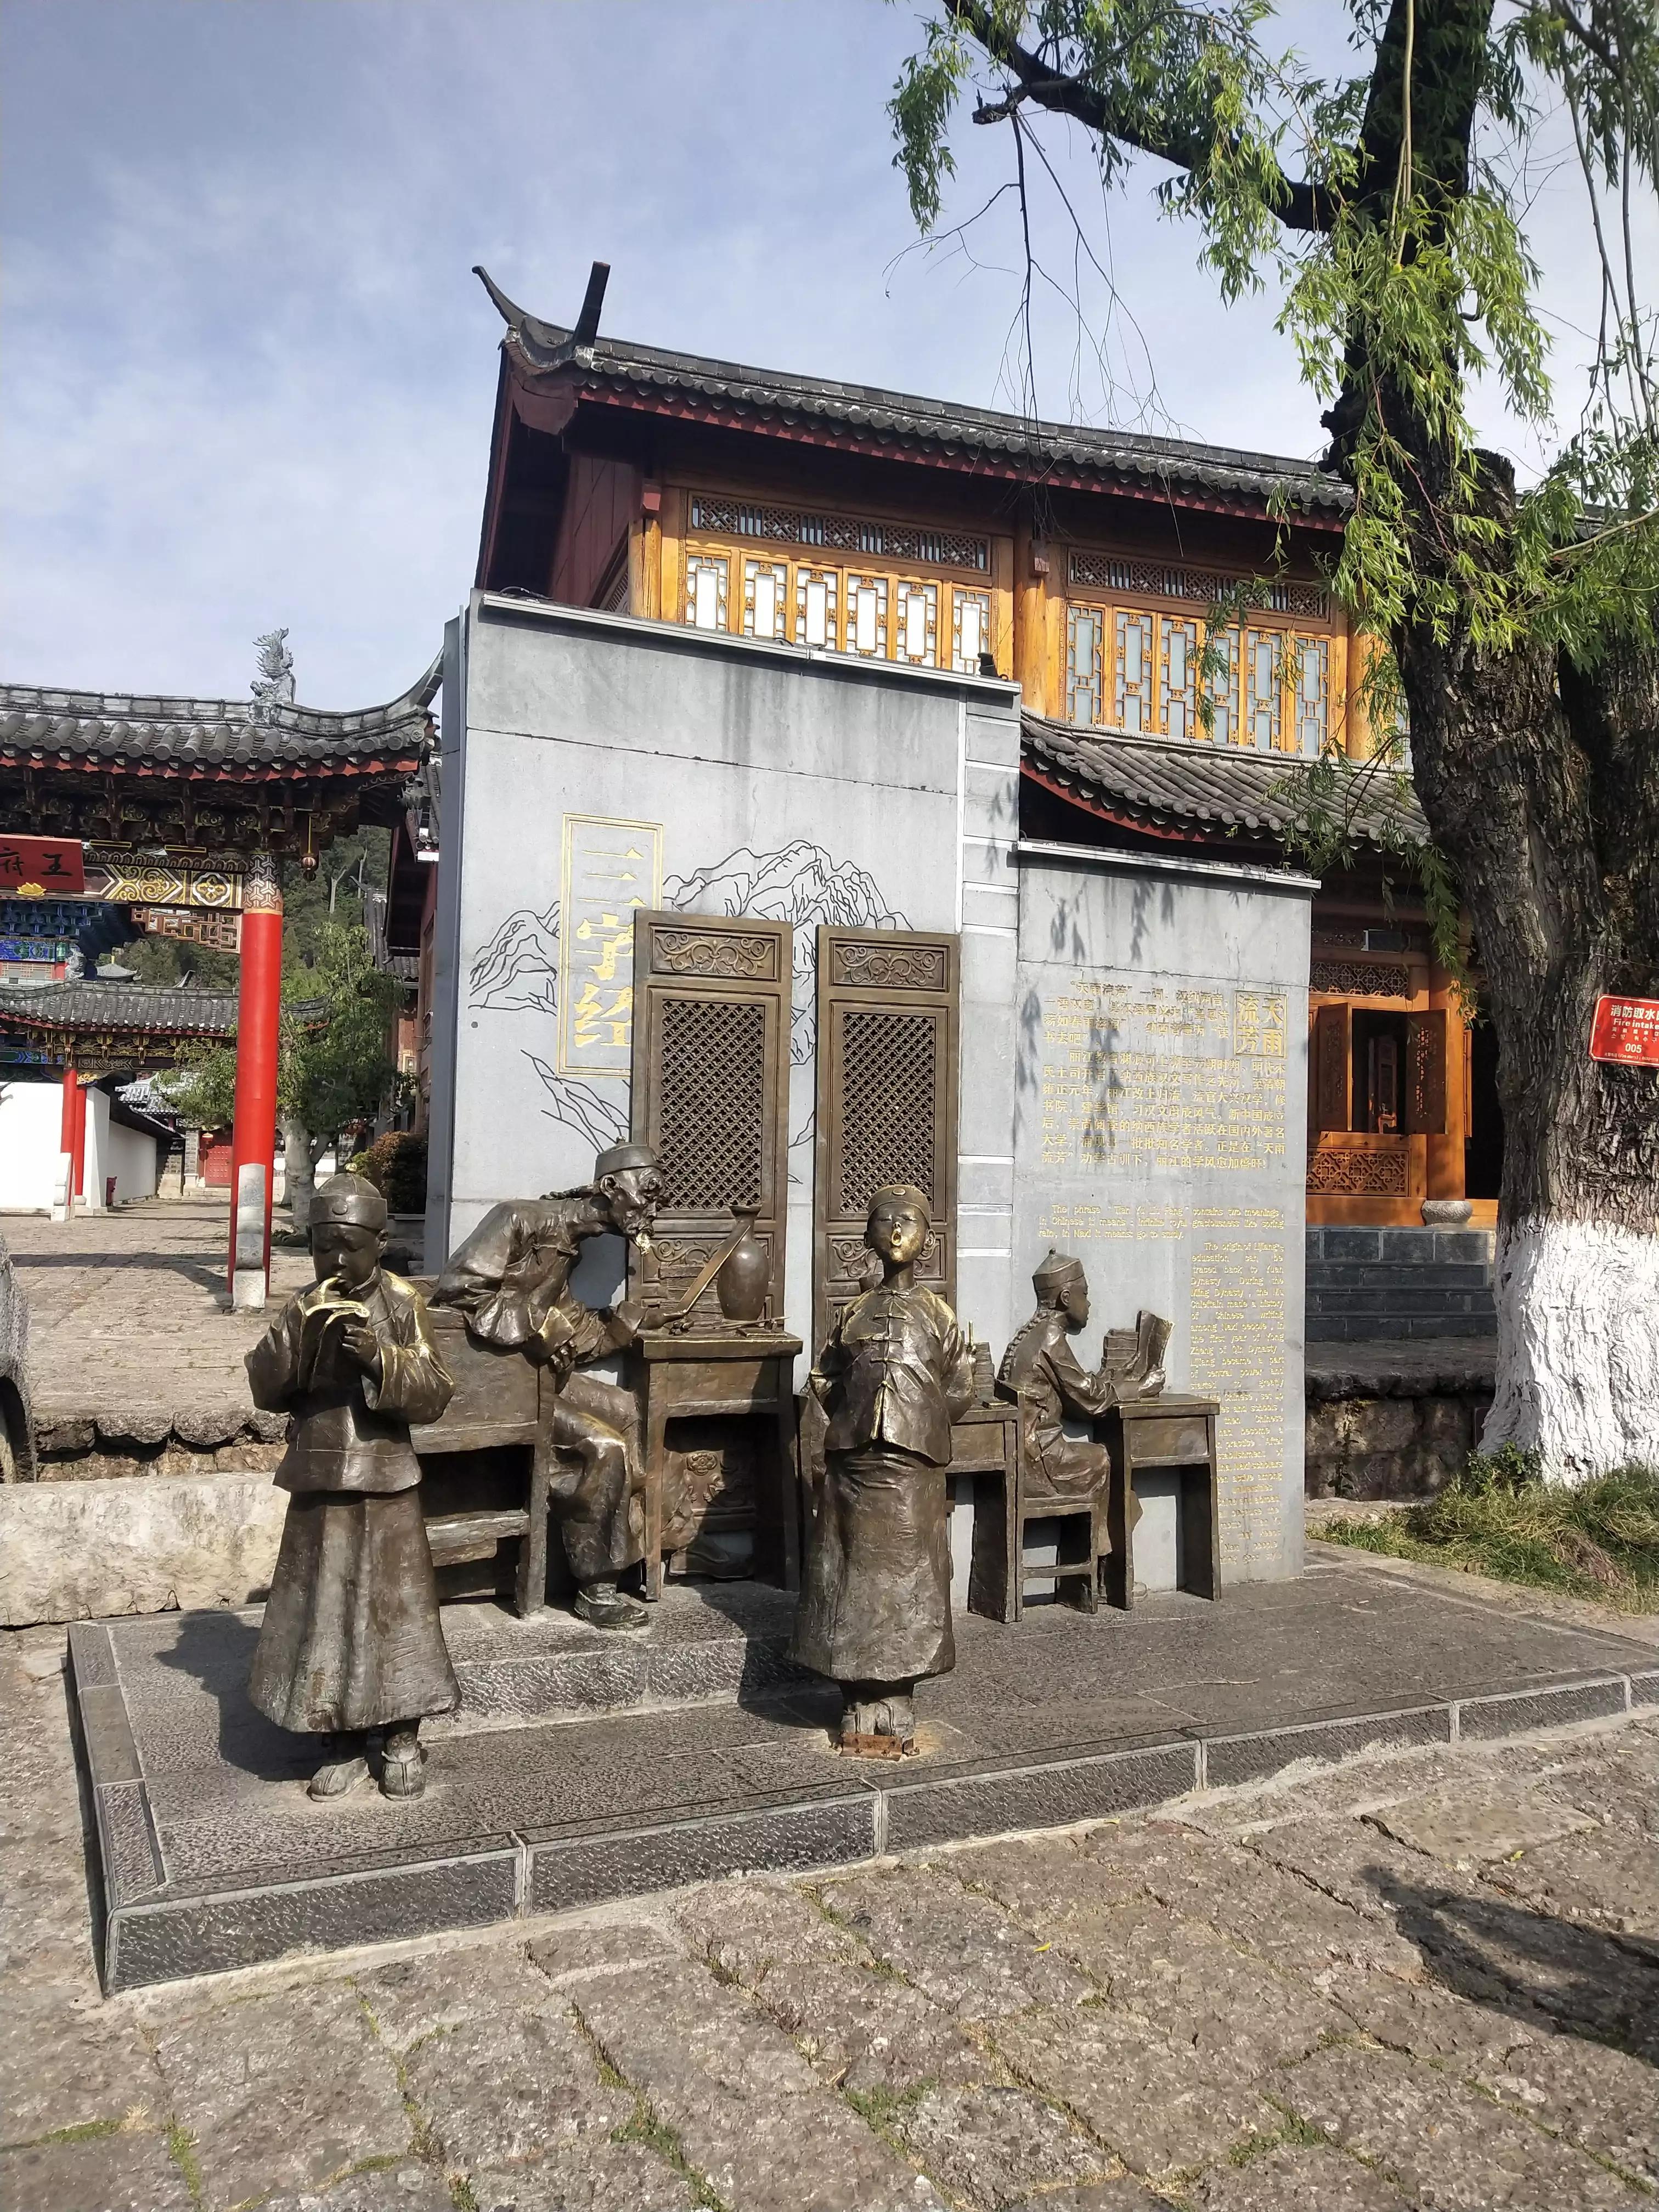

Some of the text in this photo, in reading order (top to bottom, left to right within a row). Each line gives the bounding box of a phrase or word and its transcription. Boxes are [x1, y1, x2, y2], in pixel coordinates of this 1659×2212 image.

[1611, 1005, 1659, 1020] 消防取水
[1613, 1018, 1659, 1030] Fire intake
[1625, 1043, 1642, 1053] 005
[1052, 1205, 1067, 1214] The
[1074, 1205, 1101, 1215] phrase
[1052, 1216, 1084, 1226] Chinese
[1137, 1231, 1146, 1240] go
[1204, 1242, 1218, 1250] The
[1222, 1243, 1243, 1252] origin
[1193, 1265, 1217, 1273] traced
[1224, 1265, 1243, 1273] back
[1239, 1277, 1264, 1286] During
